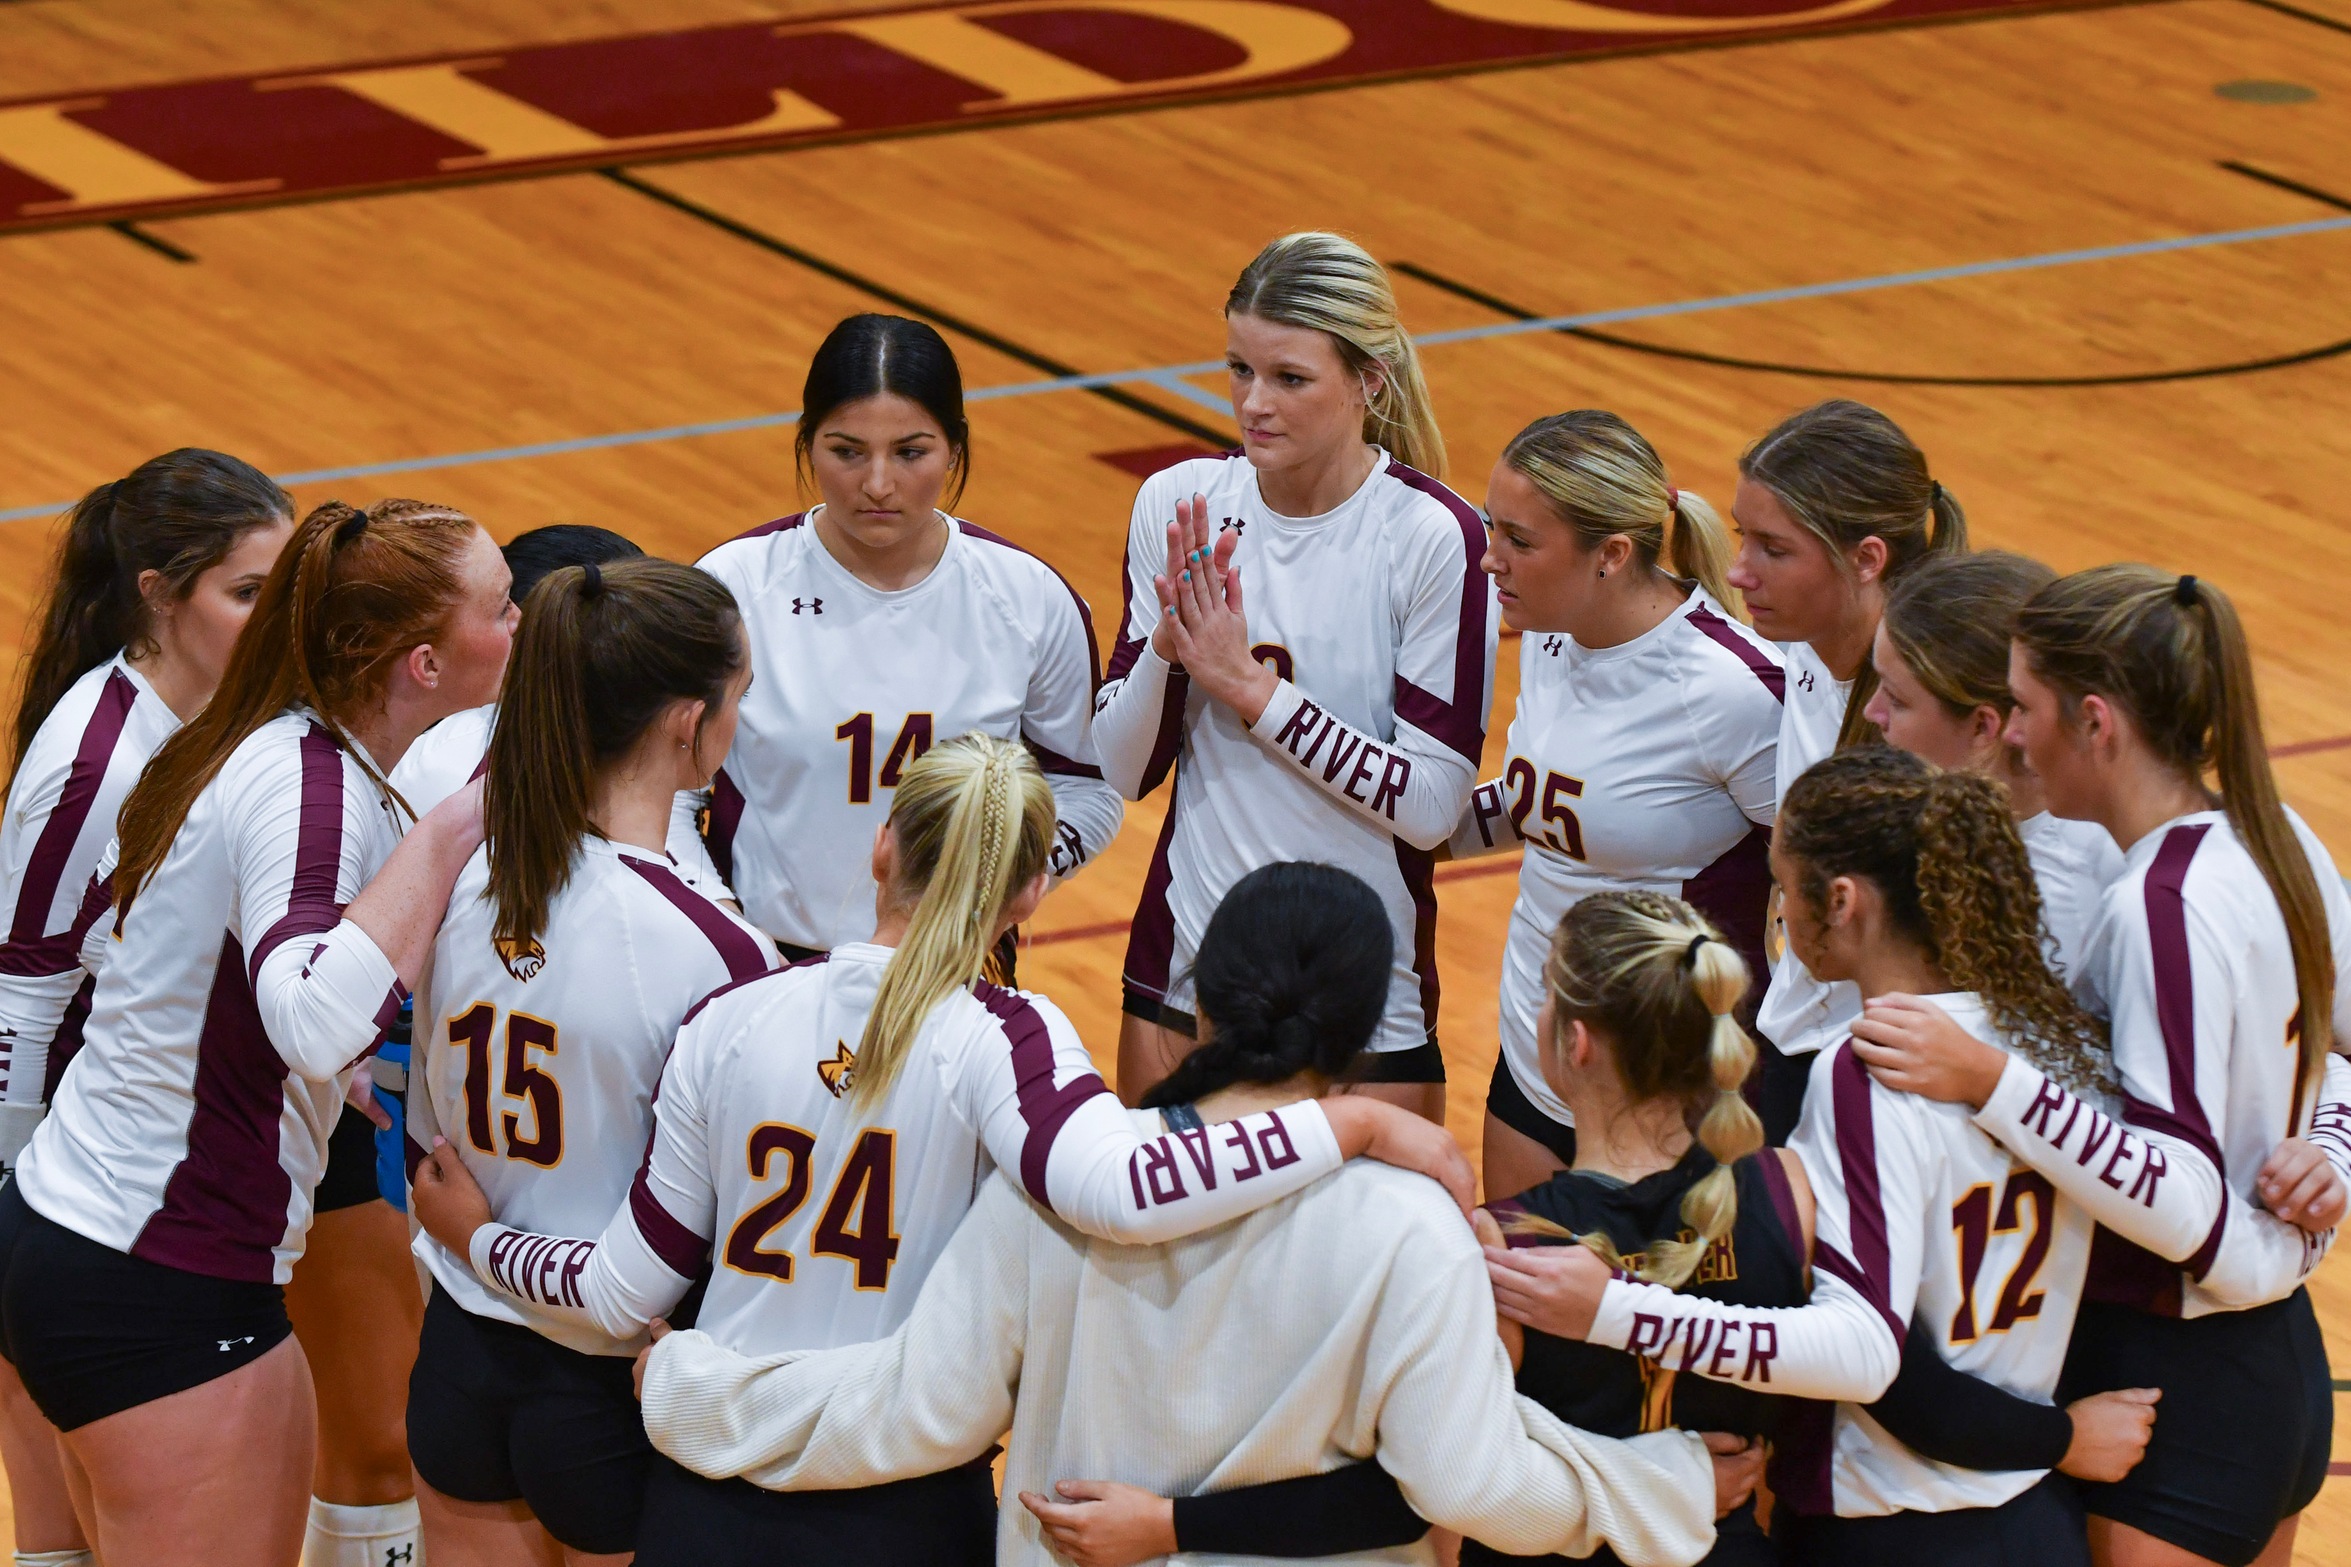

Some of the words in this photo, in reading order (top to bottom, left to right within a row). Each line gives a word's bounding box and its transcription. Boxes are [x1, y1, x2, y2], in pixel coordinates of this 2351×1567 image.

[0, 0, 1896, 215] ILD
[834, 711, 934, 804] 14
[1274, 698, 1411, 821] RIVER
[1505, 755, 1587, 863] 25
[447, 1000, 564, 1170] 15
[2020, 1077, 2167, 1208] RIVER
[488, 1231, 598, 1308] RIVER
[722, 1121, 901, 1292] 24
[1949, 1167, 2057, 1346] 12
[1624, 1312, 1778, 1383] RIVER
